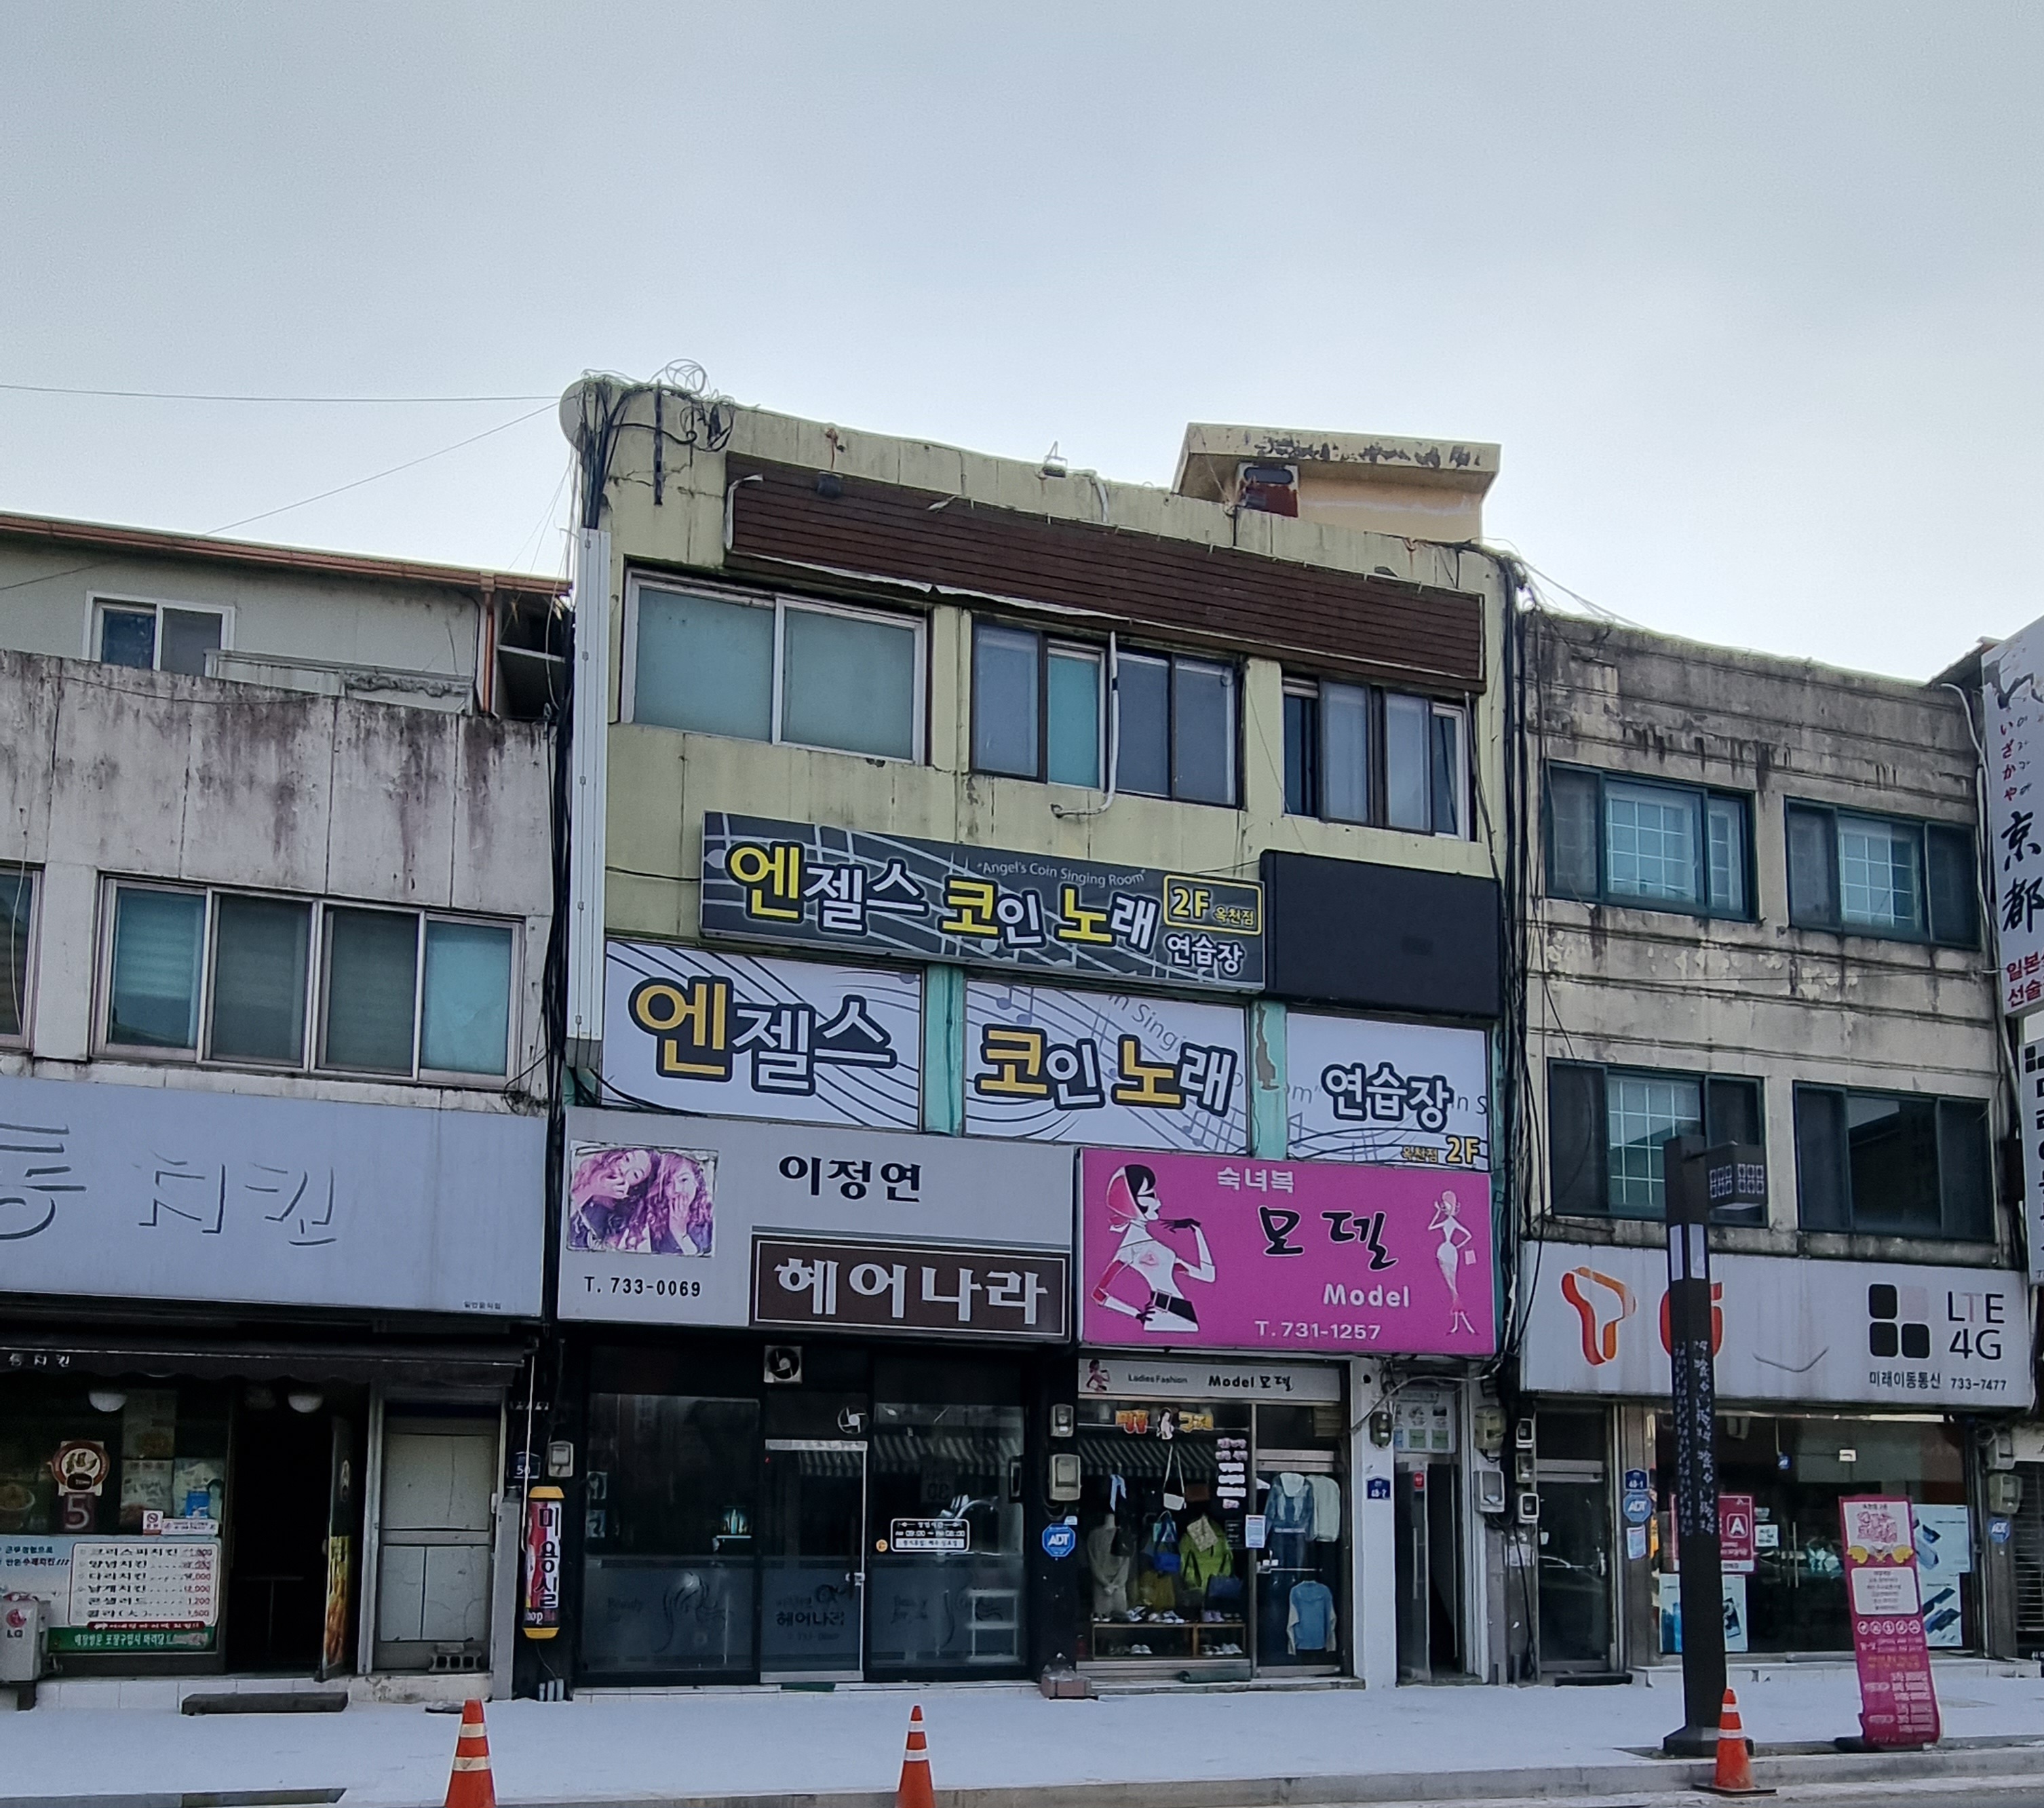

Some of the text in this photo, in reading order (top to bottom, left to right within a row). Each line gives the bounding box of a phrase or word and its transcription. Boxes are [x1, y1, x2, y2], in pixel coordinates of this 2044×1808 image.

[729, 843, 925, 931] 엔젤스
[1029, 863, 1057, 879] Coin
[1060, 868, 1106, 887] Singing
[1170, 887, 1255, 927] 2F 옥천점
[1167, 935, 1244, 973] 연습장
[2005, 950, 2044, 984] 일본
[2007, 977, 2044, 1007] 선술
[636, 982, 893, 1093] 엔젤스
[1325, 1067, 1452, 1130] 연습장
[1446, 1136, 1481, 1165] 2F
[777, 1155, 922, 1203] 이정연
[1216, 1166, 1294, 1193] 숙녀복
[1258, 1205, 1399, 1272] 모델
[611, 1276, 701, 1297] 733-0069
[773, 1257, 1048, 1325] 헤어나라
[1323, 1284, 1410, 1309] Model
[1946, 1290, 2005, 1324] LTE
[1281, 1322, 1382, 1341] 731-1257
[1948, 1328, 2003, 1361] 4G
[1208, 1373, 1256, 1389] Model
[1868, 1370, 2007, 1393] 미래이동통신 733-7477
[1628, 1500, 1648, 1512] ADT
[1047, 1533, 1070, 1546] ADT
[1730, 1516, 1746, 1535] A
[534, 1507, 561, 1608] 미용실
[775, 1611, 845, 1627] 헤어나라
[6, 1630, 23, 1639] LG
